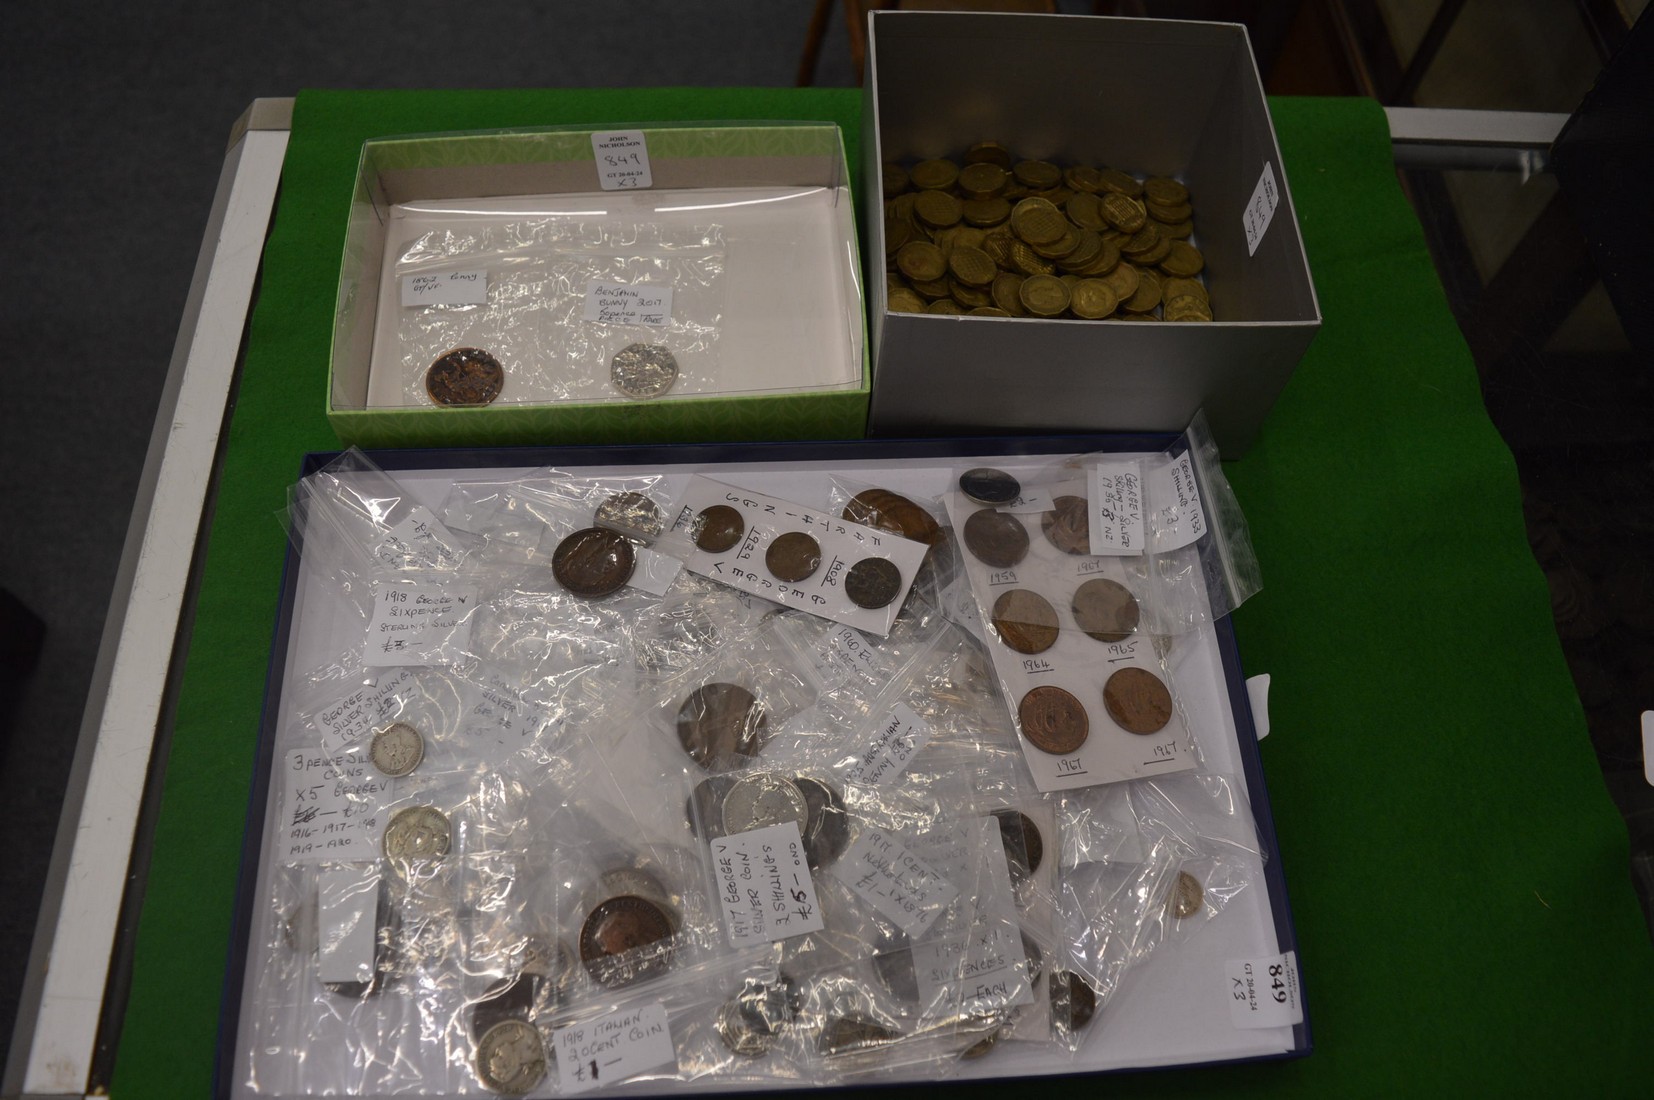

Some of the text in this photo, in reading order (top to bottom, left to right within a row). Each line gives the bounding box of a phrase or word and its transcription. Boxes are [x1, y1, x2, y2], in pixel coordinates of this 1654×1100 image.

[598, 141, 641, 149] NICHOLSON
[604, 153, 641, 167] 849
[595, 285, 640, 298] BENJAMIN
[599, 299, 629, 311] BUNNY
[1189, 508, 1201, 534] 1933
[739, 529, 762, 561] 1929
[825, 559, 846, 587] 1908
[989, 571, 1018, 583] 1959
[384, 590, 408, 603] 1918
[1106, 640, 1139, 655] 1965
[1022, 659, 1051, 671] 1964
[321, 678, 379, 727] GEORGE V
[332, 704, 364, 736] SILVER
[292, 754, 304, 771] 3
[1056, 758, 1083, 773] 1967
[323, 767, 364, 780] COINS
[333, 781, 379, 798] GEORGE
[379, 779, 389, 791] V
[715, 845, 749, 938] 1917 GEORGE V
[1244, 963, 1253, 976] GT
[1268, 964, 1288, 1004] 849
[562, 1030, 585, 1048] 1918
[629, 1023, 664, 1042] COIN
